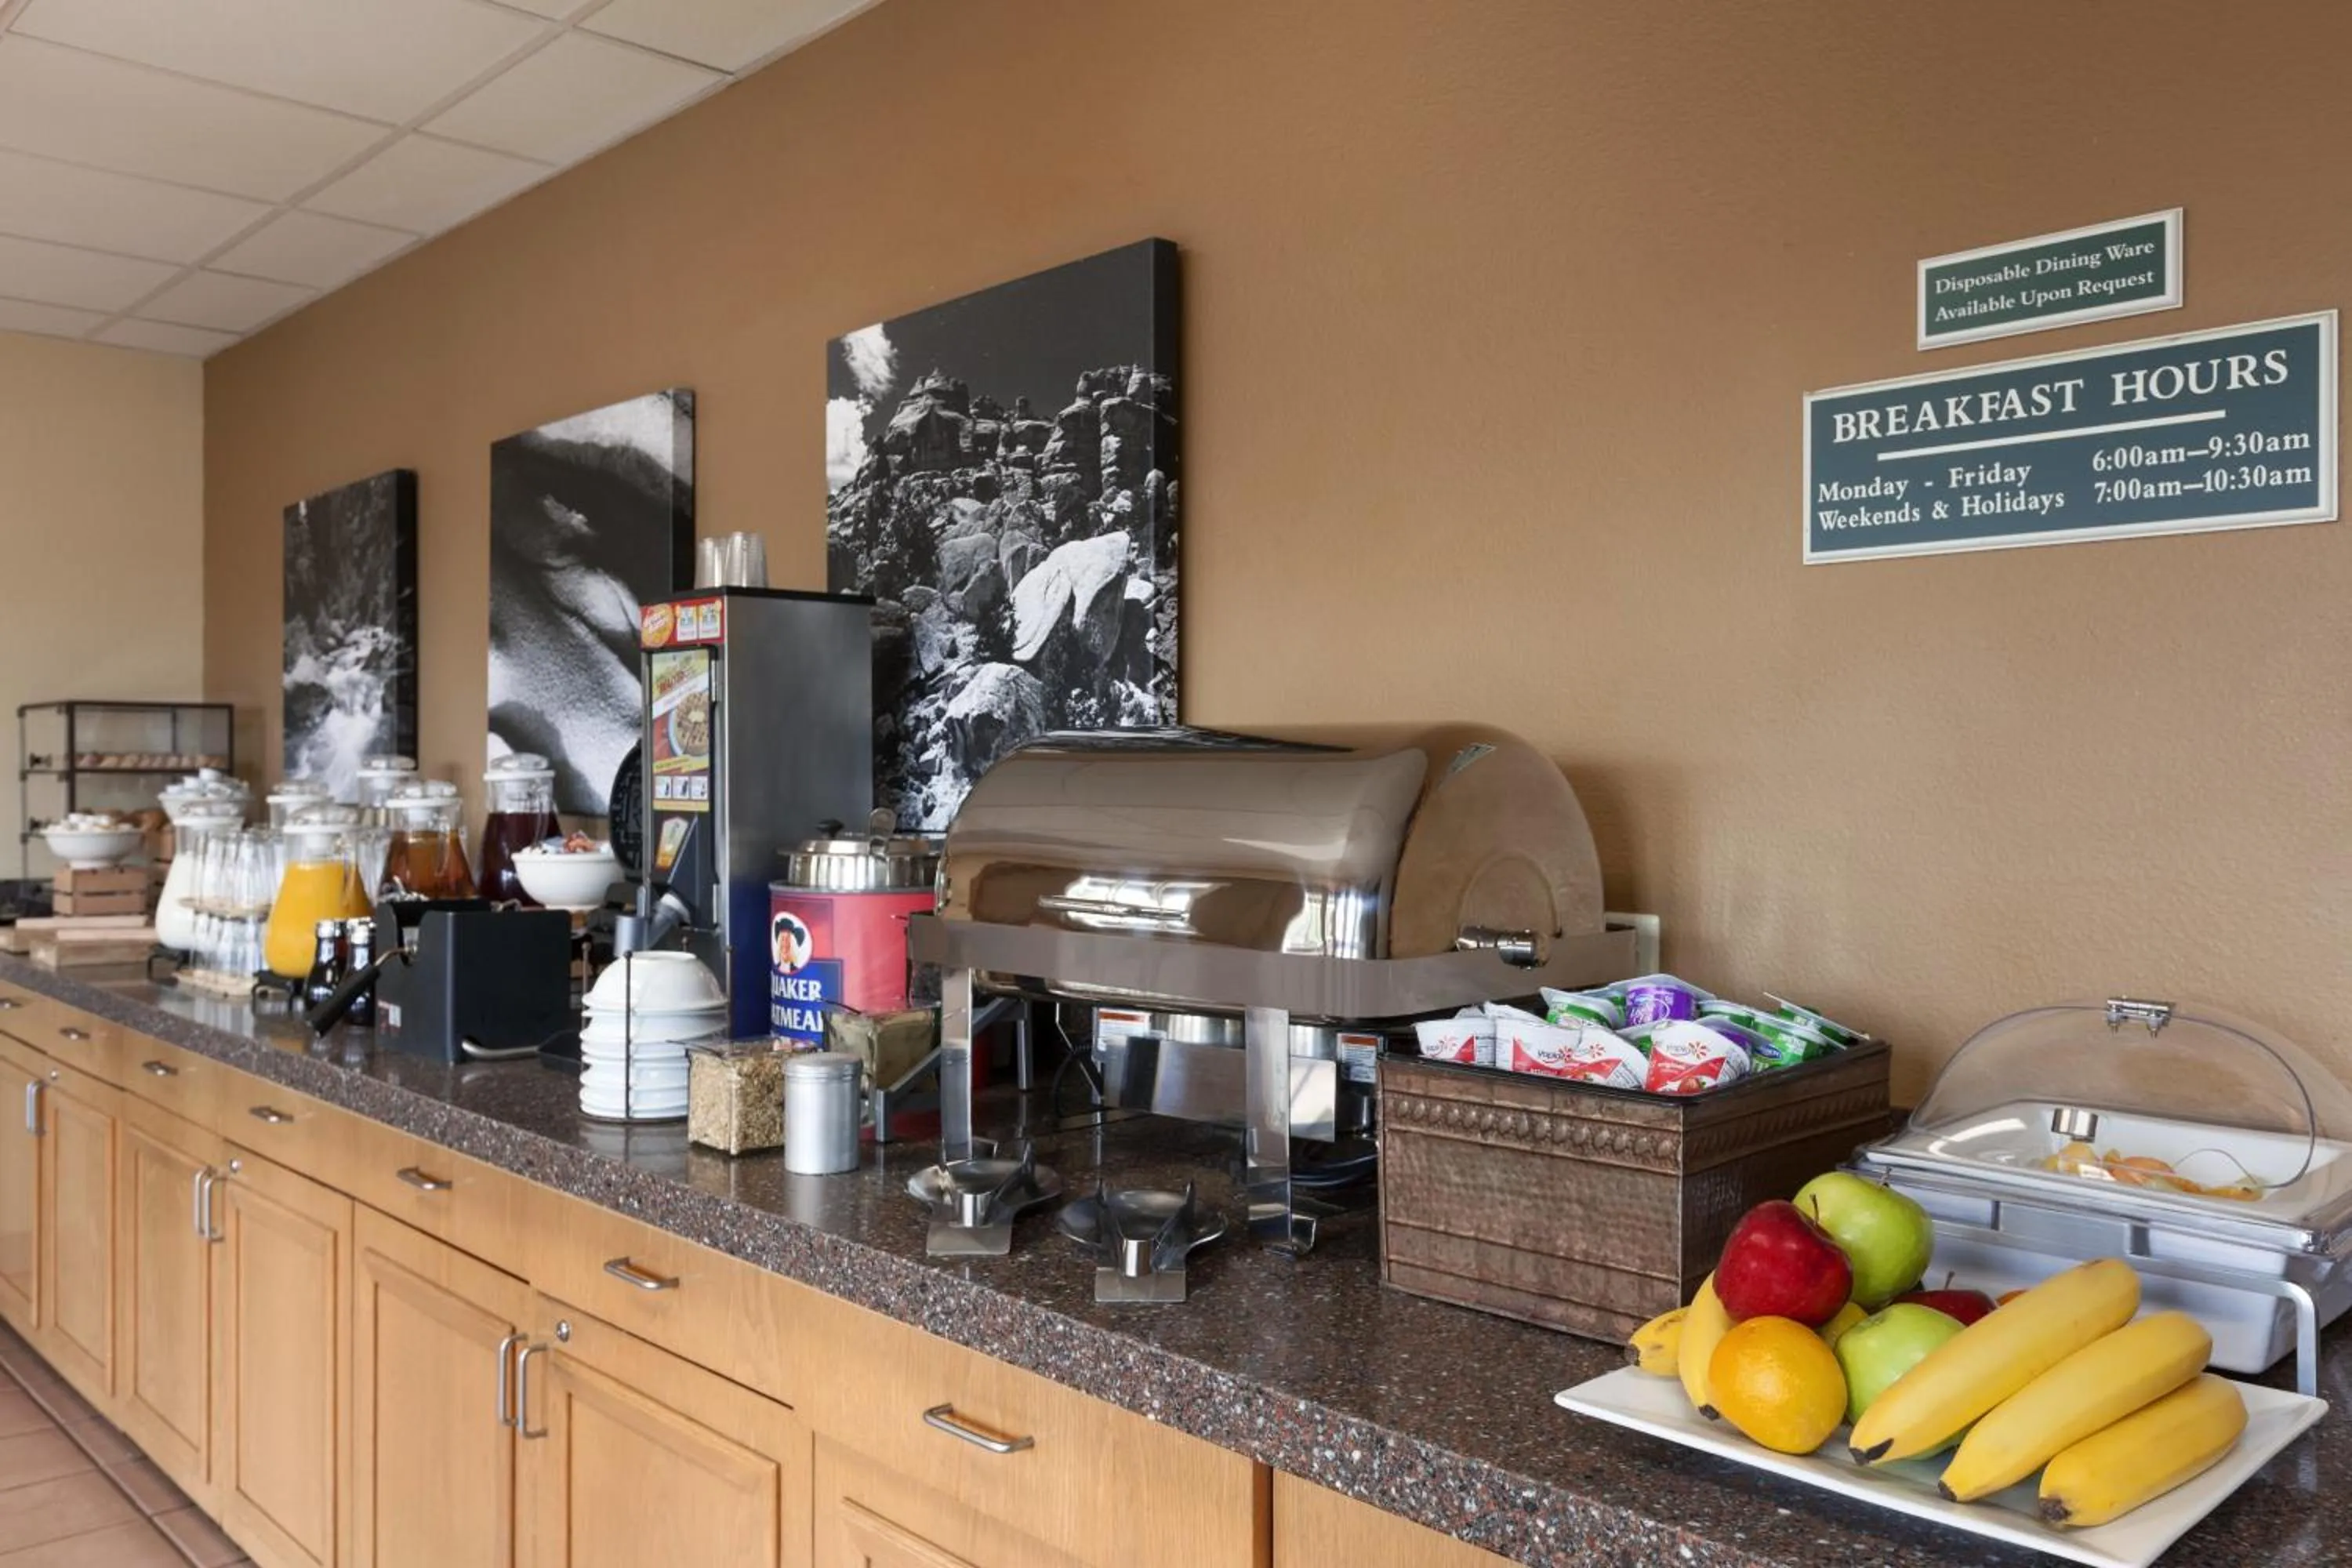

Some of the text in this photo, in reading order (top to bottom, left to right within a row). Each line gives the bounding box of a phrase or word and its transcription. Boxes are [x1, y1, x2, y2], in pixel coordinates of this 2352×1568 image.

[1935, 243, 2154, 294] Disposable Dining Ware
[1935, 270, 2155, 321] Available Upon Request
[1833, 350, 2288, 443] BREAKFAST HOURS
[1818, 476, 1909, 503] Monday
[1949, 462, 2031, 488] Friday
[1818, 490, 2064, 531] Weekends & Holidays
[770, 970, 822, 1003] UAKER
